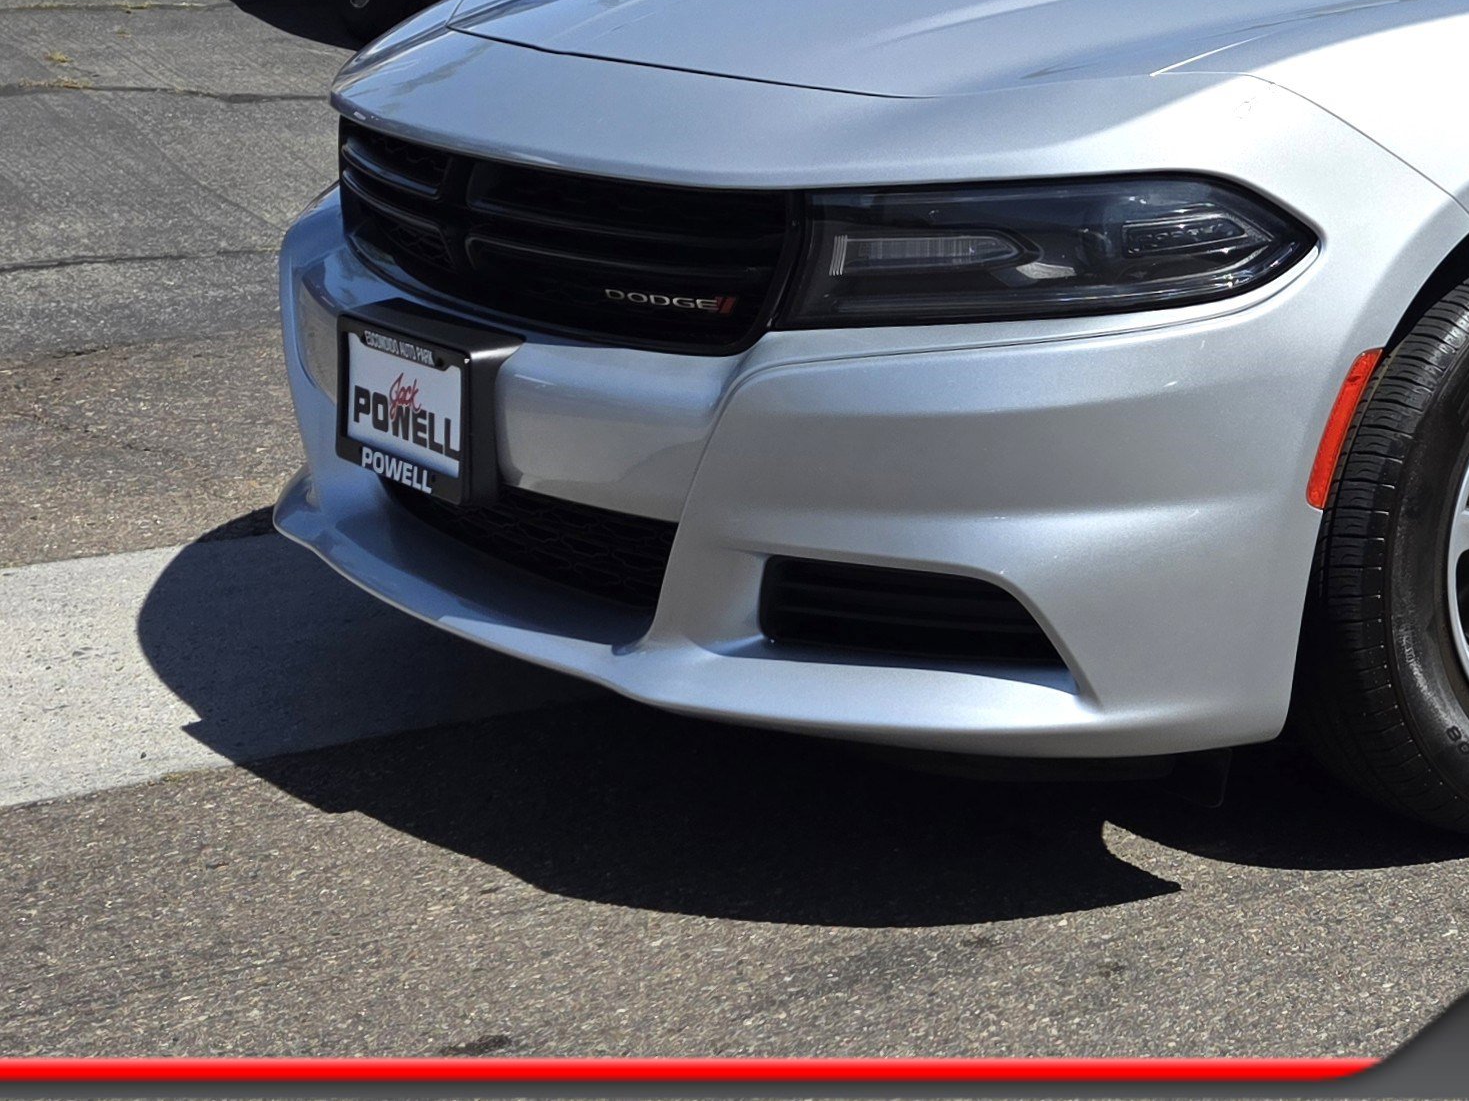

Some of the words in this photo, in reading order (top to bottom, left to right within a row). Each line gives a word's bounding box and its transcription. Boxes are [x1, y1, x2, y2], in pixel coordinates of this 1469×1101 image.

[605, 289, 720, 311] DODGE
[364, 329, 400, 356] ESCONDIDO
[399, 340, 417, 360] AUTO
[416, 345, 435, 367] PARK
[389, 372, 422, 422] Jack
[353, 384, 460, 462] POWELL
[361, 446, 432, 494] POWELL
